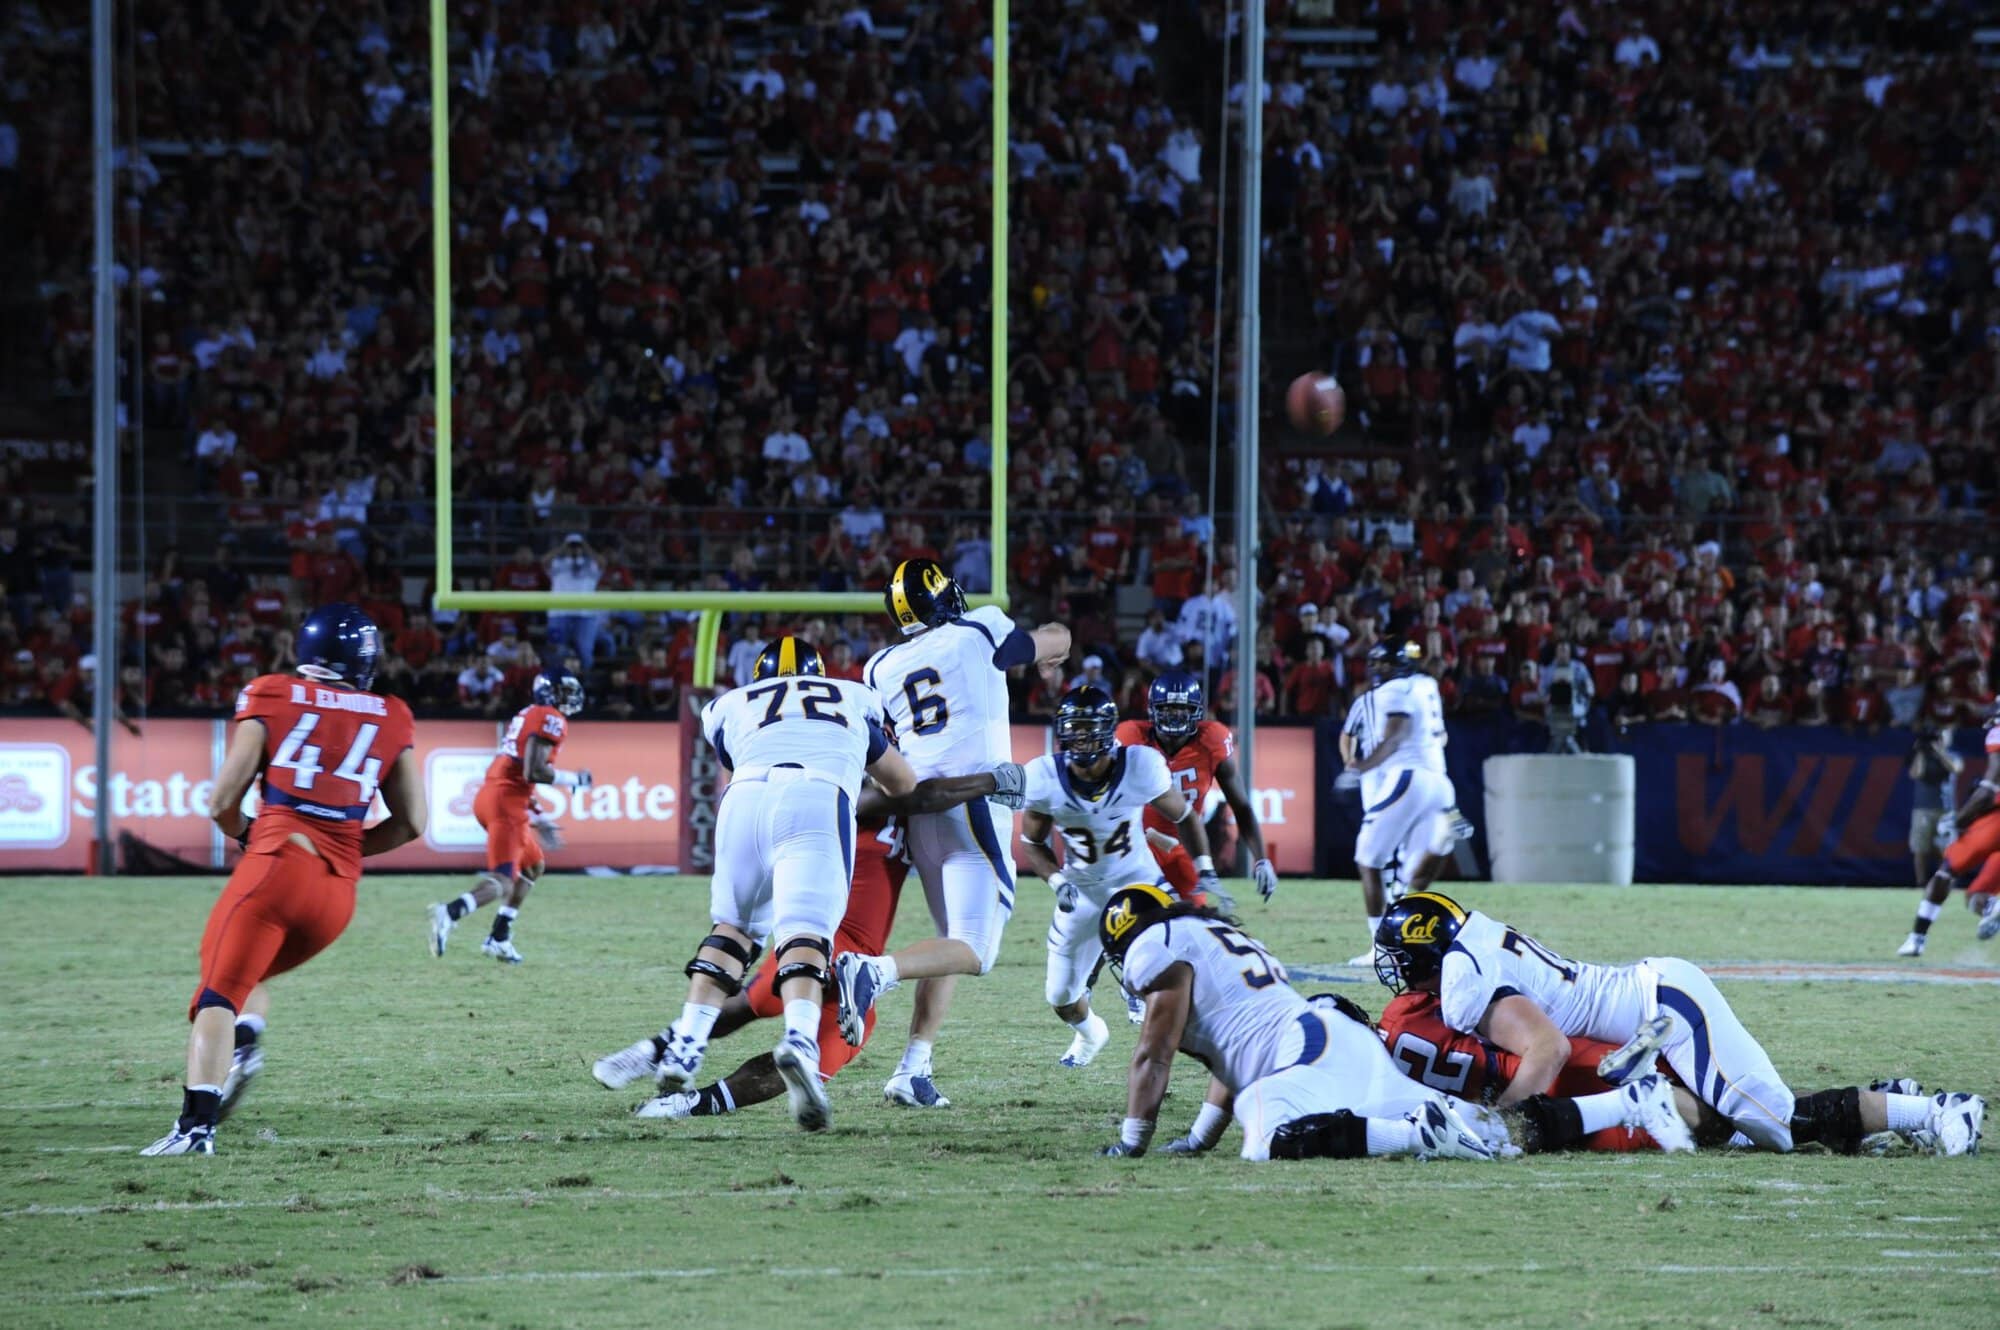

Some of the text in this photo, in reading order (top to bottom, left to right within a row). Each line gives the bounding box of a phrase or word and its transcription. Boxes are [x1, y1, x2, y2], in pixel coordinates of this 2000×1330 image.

[746, 680, 849, 729] 72
[903, 666, 951, 737] 6
[270, 711, 383, 803] 44
[72, 765, 214, 818] State
[532, 776, 676, 821] State
[1062, 820, 1134, 866] 34
[1105, 897, 1137, 941] Cal
[1401, 913, 1440, 944] Cal
